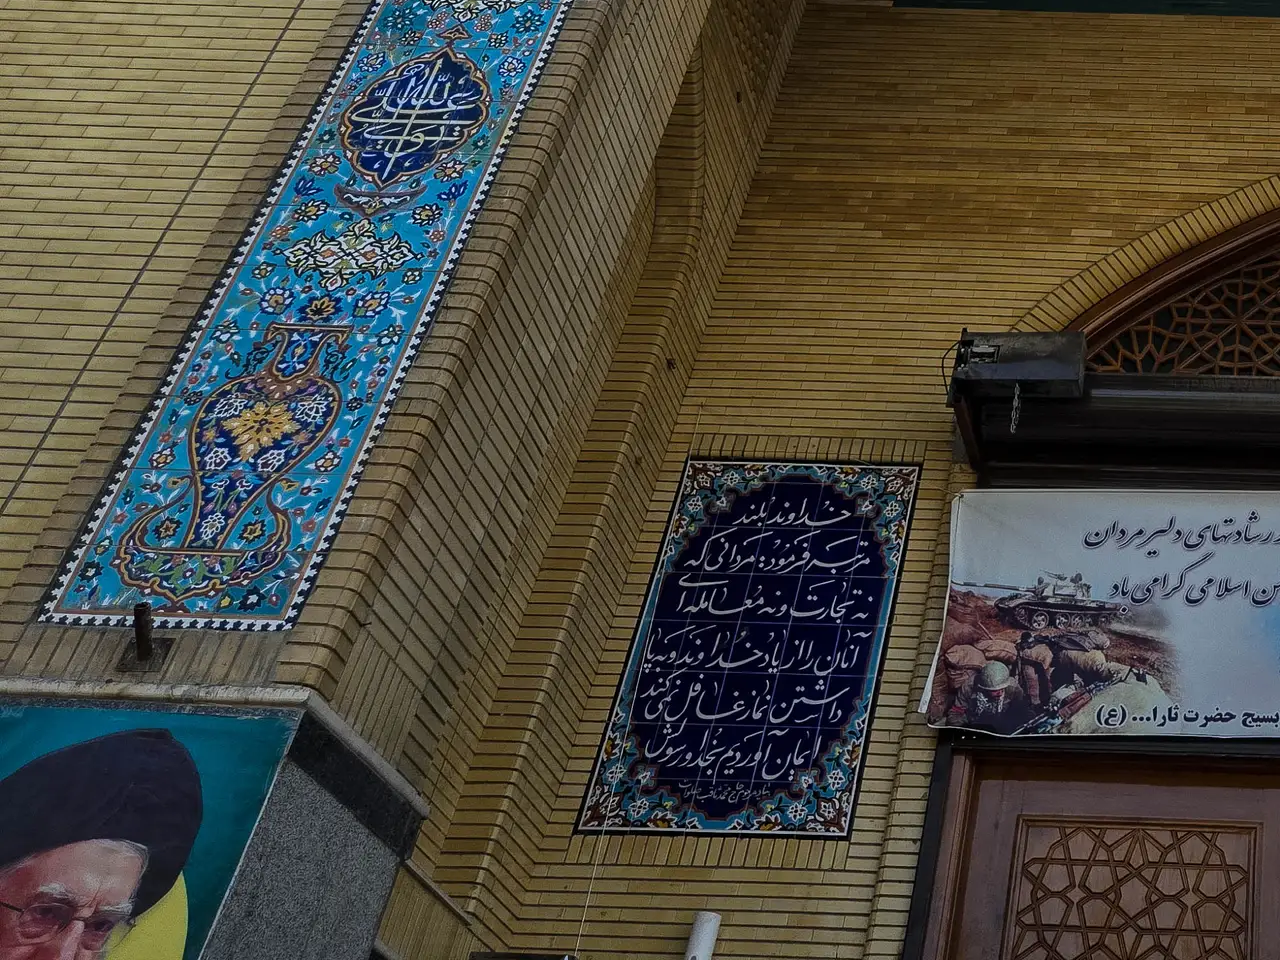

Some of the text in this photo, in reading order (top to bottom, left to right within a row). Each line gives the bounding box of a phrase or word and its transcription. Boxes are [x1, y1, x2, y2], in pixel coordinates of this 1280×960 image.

[732, 497, 851, 527] خداوند بلند
[684, 527, 737, 567] که
[805, 536, 870, 574] مرتبه
[1109, 575, 1130, 615] باد
[1130, 550, 1215, 605] گرامی
[1184, 575, 1250, 606] اسلامی
[790, 589, 863, 623] تجارت
[851, 596, 874, 619] نه
[758, 632, 780, 673] یاد
[800, 640, 814, 670] را
[814, 629, 872, 676] آنان
[665, 674, 745, 721] غافل
[736, 680, 771, 721] نماز
[769, 680, 850, 724] داشتن
[1096, 704, 1127, 728] (ع)
[1183, 706, 1237, 729] حضرت
[1241, 709, 1279, 729] بسیج
[713, 728, 789, 784] آوردیم
[762, 731, 822, 780] ایمان
